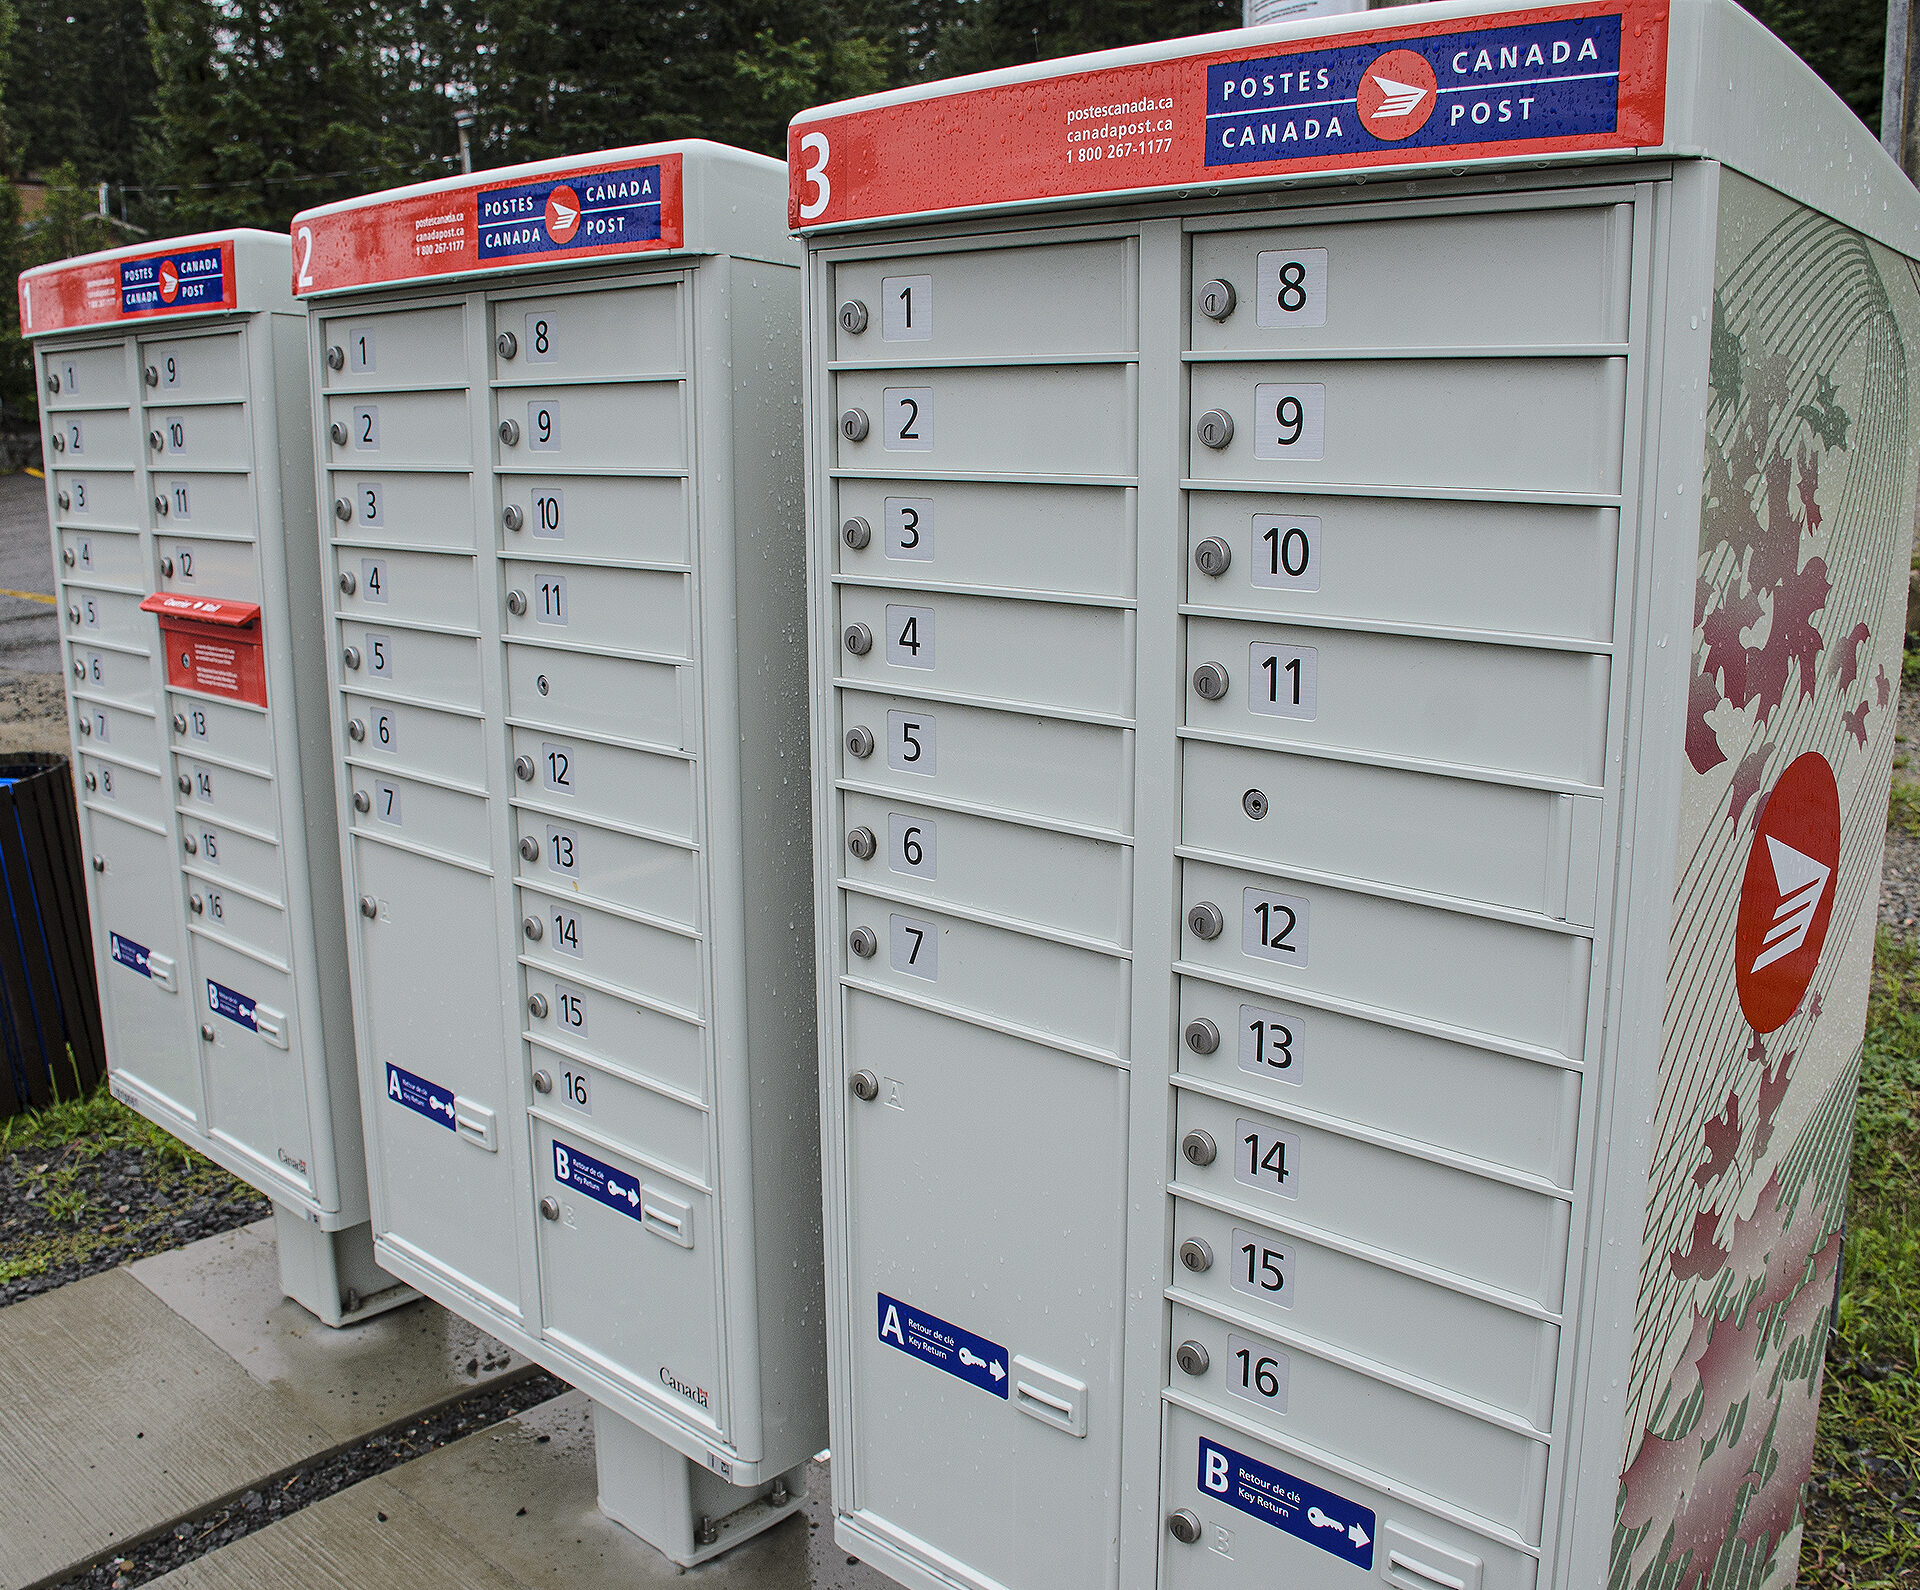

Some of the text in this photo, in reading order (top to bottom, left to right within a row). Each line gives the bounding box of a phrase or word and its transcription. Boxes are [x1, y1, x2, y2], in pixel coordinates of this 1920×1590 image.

[1451, 37, 1600, 76] CANADA
[1222, 67, 1331, 102] POSTES
[1066, 96, 1174, 126] postescanada.ca
[1450, 97, 1537, 128] POST
[1066, 119, 1174, 143] canadapost.ca
[1220, 116, 1345, 150] CANADA
[1066, 138, 1173, 164] 1 800 267-1177
[800, 131, 832, 219] 3
[586, 179, 653, 204] CANADA
[416, 213, 464, 230] postescanada.ca
[484, 197, 534, 218] POSTES
[416, 227, 464, 242] canadapost.ca
[484, 227, 542, 249] CANADA
[586, 216, 626, 237] POST
[297, 226, 314, 288] 2
[416, 240, 464, 256] 1 800 267-1177
[125, 267, 153, 282] POSTES
[181, 258, 218, 273] CANADA
[126, 290, 158, 305] CANADA
[182, 284, 204, 298] POST
[1277, 262, 1307, 312] 8
[23, 281, 33, 329] 1
[899, 287, 912, 328] 1
[359, 336, 366, 365] 1
[535, 320, 549, 354] 8
[67, 366, 74, 389] 1
[167, 357, 176, 383] 9
[362, 414, 373, 443] 2
[538, 409, 551, 443] 9
[899, 398, 919, 440] 2
[1276, 396, 1304, 446] 9
[72, 426, 80, 449] 2
[170, 423, 183, 448] 10
[77, 484, 85, 507] 3
[176, 489, 187, 512] 11
[366, 490, 377, 519] 3
[537, 497, 559, 530] 10
[900, 508, 920, 549] 3
[82, 543, 90, 568] 4
[180, 553, 193, 577] 12
[1262, 527, 1310, 577] 10
[369, 567, 381, 595] 4
[88, 602, 95, 624] 5
[541, 583, 561, 616] 11
[898, 616, 921, 657] 4
[93, 659, 100, 681] 6
[374, 642, 385, 670] 5
[1261, 656, 1301, 705] 11
[96, 714, 105, 737] 7
[193, 711, 206, 736] 13
[379, 716, 390, 744] 6
[903, 722, 921, 762] 5
[103, 771, 112, 793] 8
[548, 752, 570, 786] 12
[198, 773, 212, 797] 14
[383, 788, 393, 816] 7
[203, 833, 217, 858] 15
[552, 834, 574, 868] 13
[903, 826, 923, 866] 6
[209, 894, 222, 918] 16
[555, 915, 579, 949] 14
[1253, 902, 1296, 953] 12
[112, 935, 122, 961] A
[905, 926, 924, 965] 7
[208, 983, 220, 1009] B
[560, 993, 583, 1027] 15
[1249, 1020, 1293, 1069] 13
[389, 1070, 402, 1099] A
[564, 1071, 587, 1105] 16
[556, 1147, 570, 1179] B
[1243, 1133, 1289, 1184] 14
[1241, 1243, 1285, 1292] 15
[881, 1304, 905, 1345] A
[908, 1318, 955, 1347] Retour de clé
[908, 1335, 947, 1360] Key Return
[659, 1366, 709, 1409] Canada
[1235, 1349, 1279, 1398] 16
[1205, 1447, 1229, 1493] B
[1239, 1467, 1301, 1504] Retour de clé
[1238, 1486, 1289, 1518] Key Return
